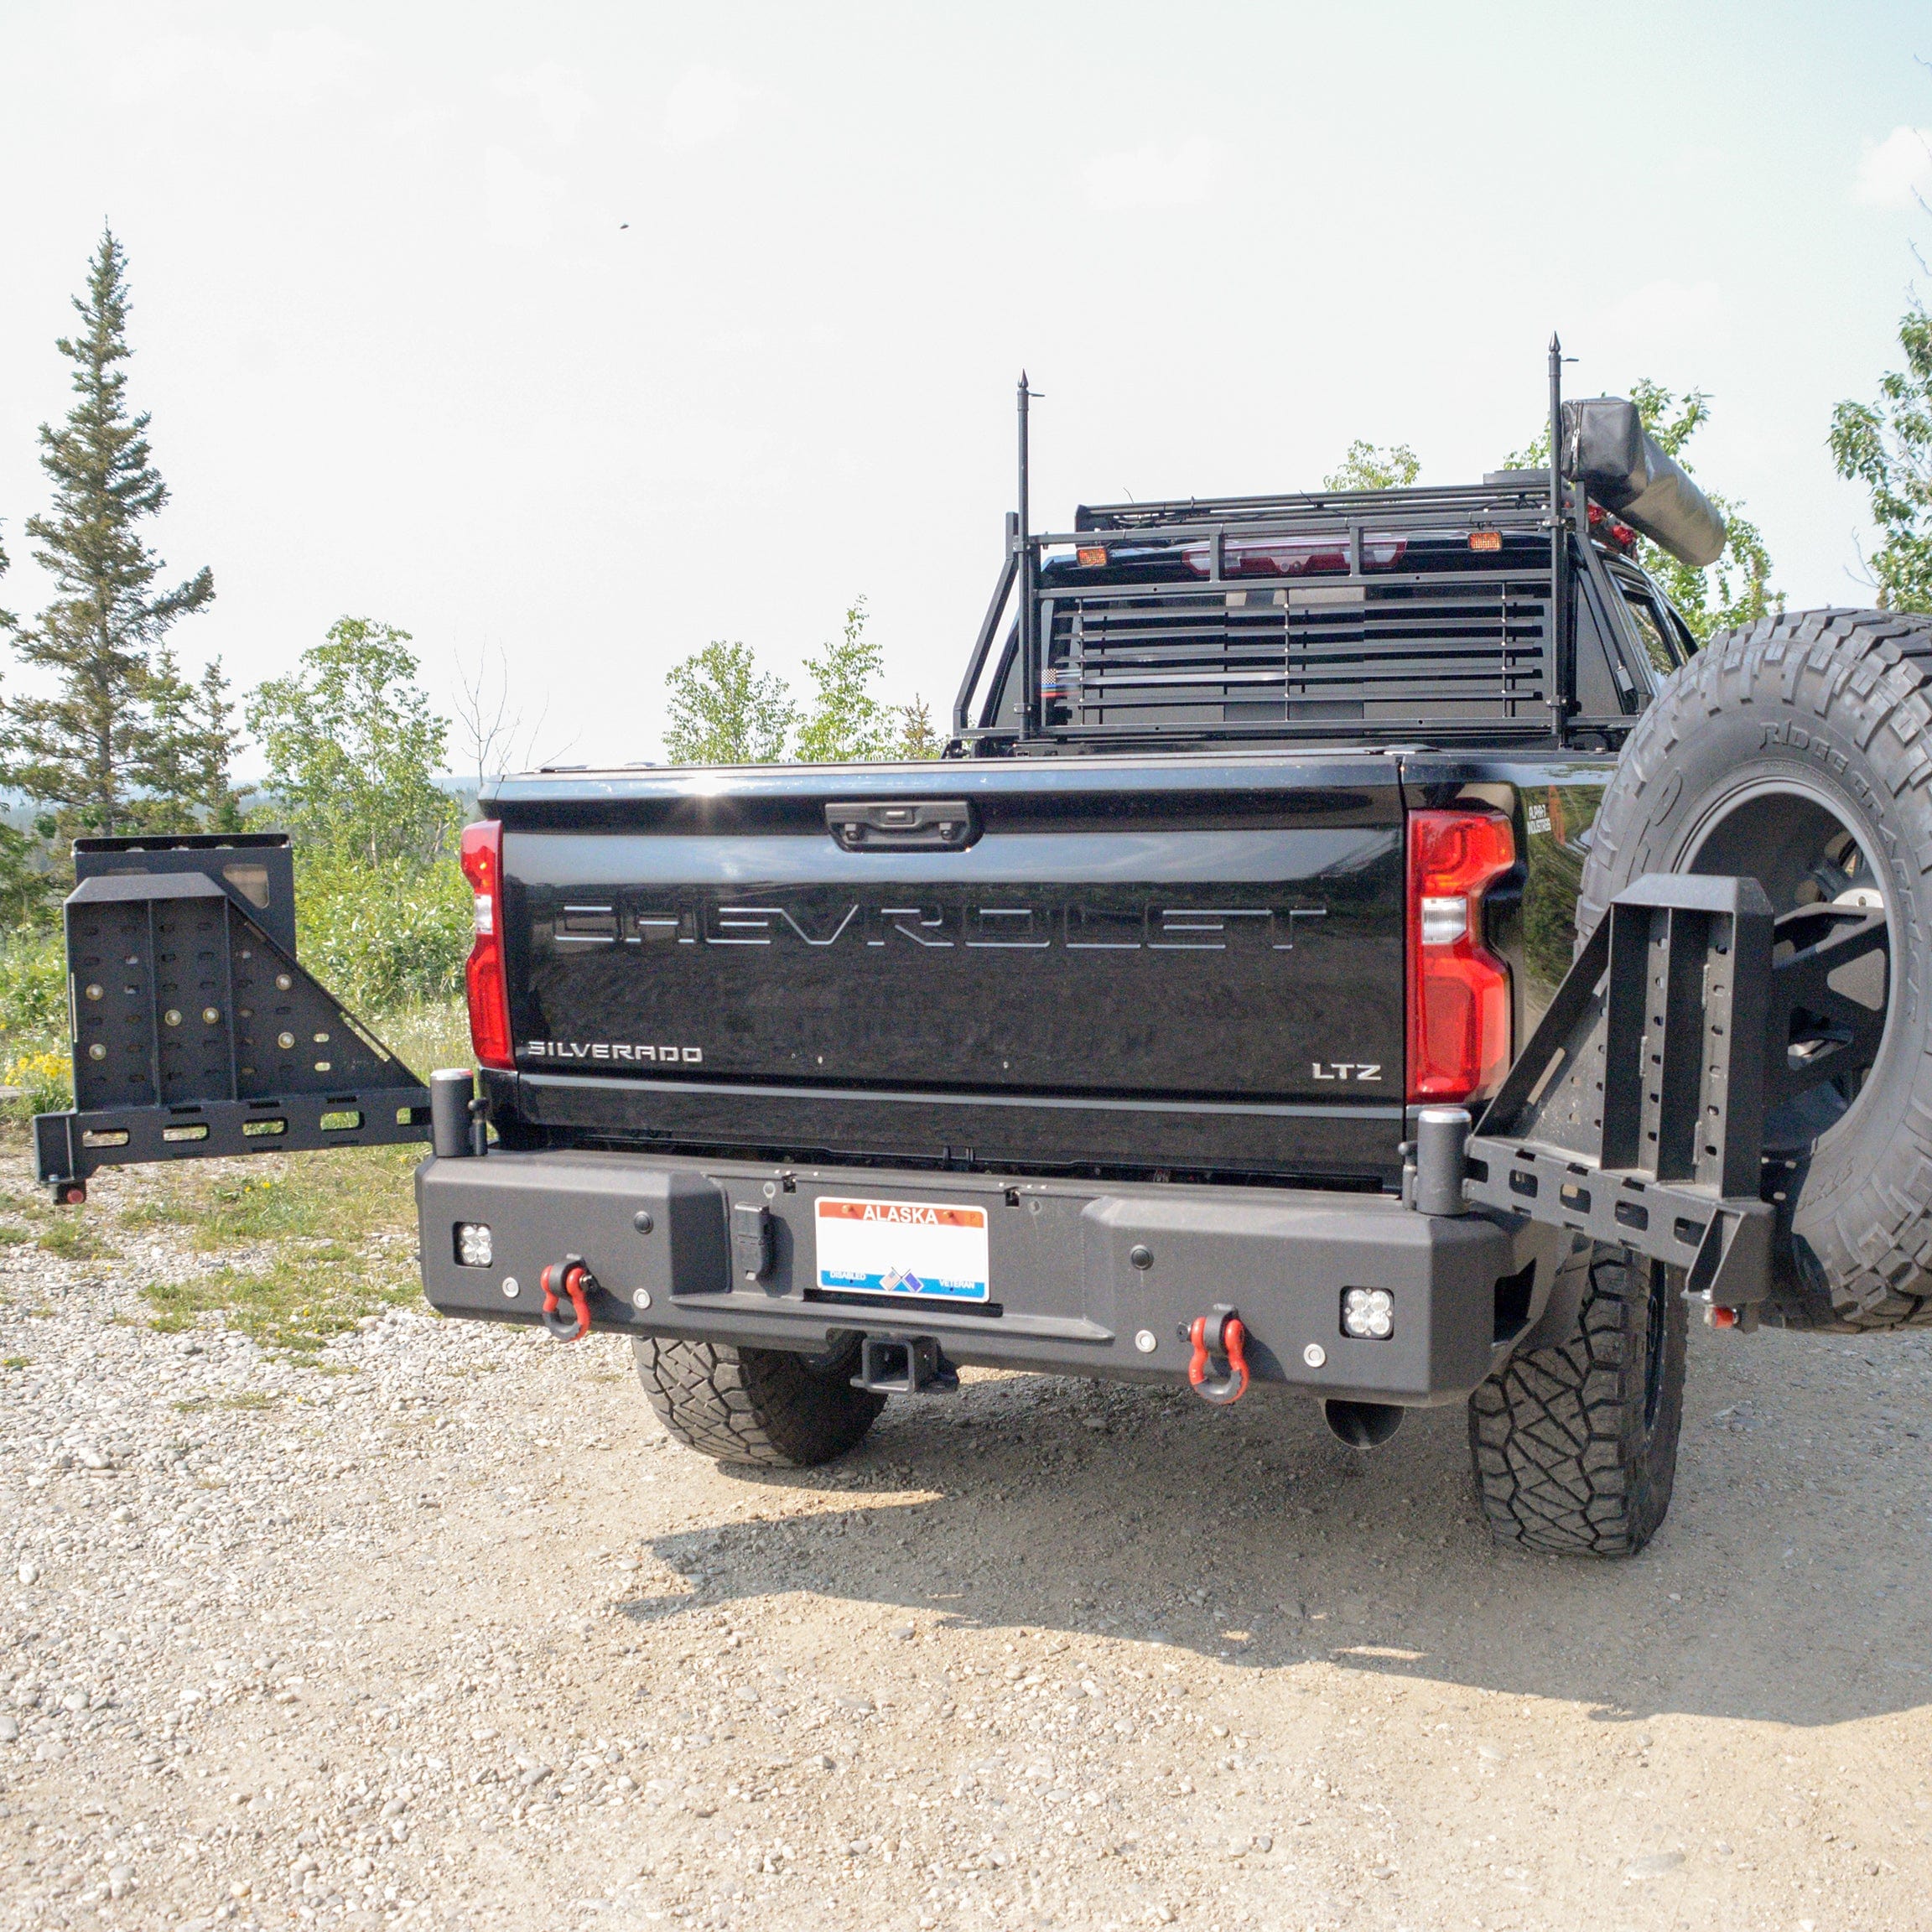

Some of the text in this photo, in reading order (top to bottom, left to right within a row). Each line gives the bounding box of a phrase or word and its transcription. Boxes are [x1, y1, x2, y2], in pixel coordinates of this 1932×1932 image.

[1759, 719, 1849, 776] RIDGE
[553, 901, 1328, 949] CHEVROLET
[527, 1040, 704, 1062] SILVERADO
[1311, 1062, 1383, 1081] LTZ
[863, 1205, 938, 1223] ALASKA
[829, 1271, 974, 1289] DISABLED VETERAN
